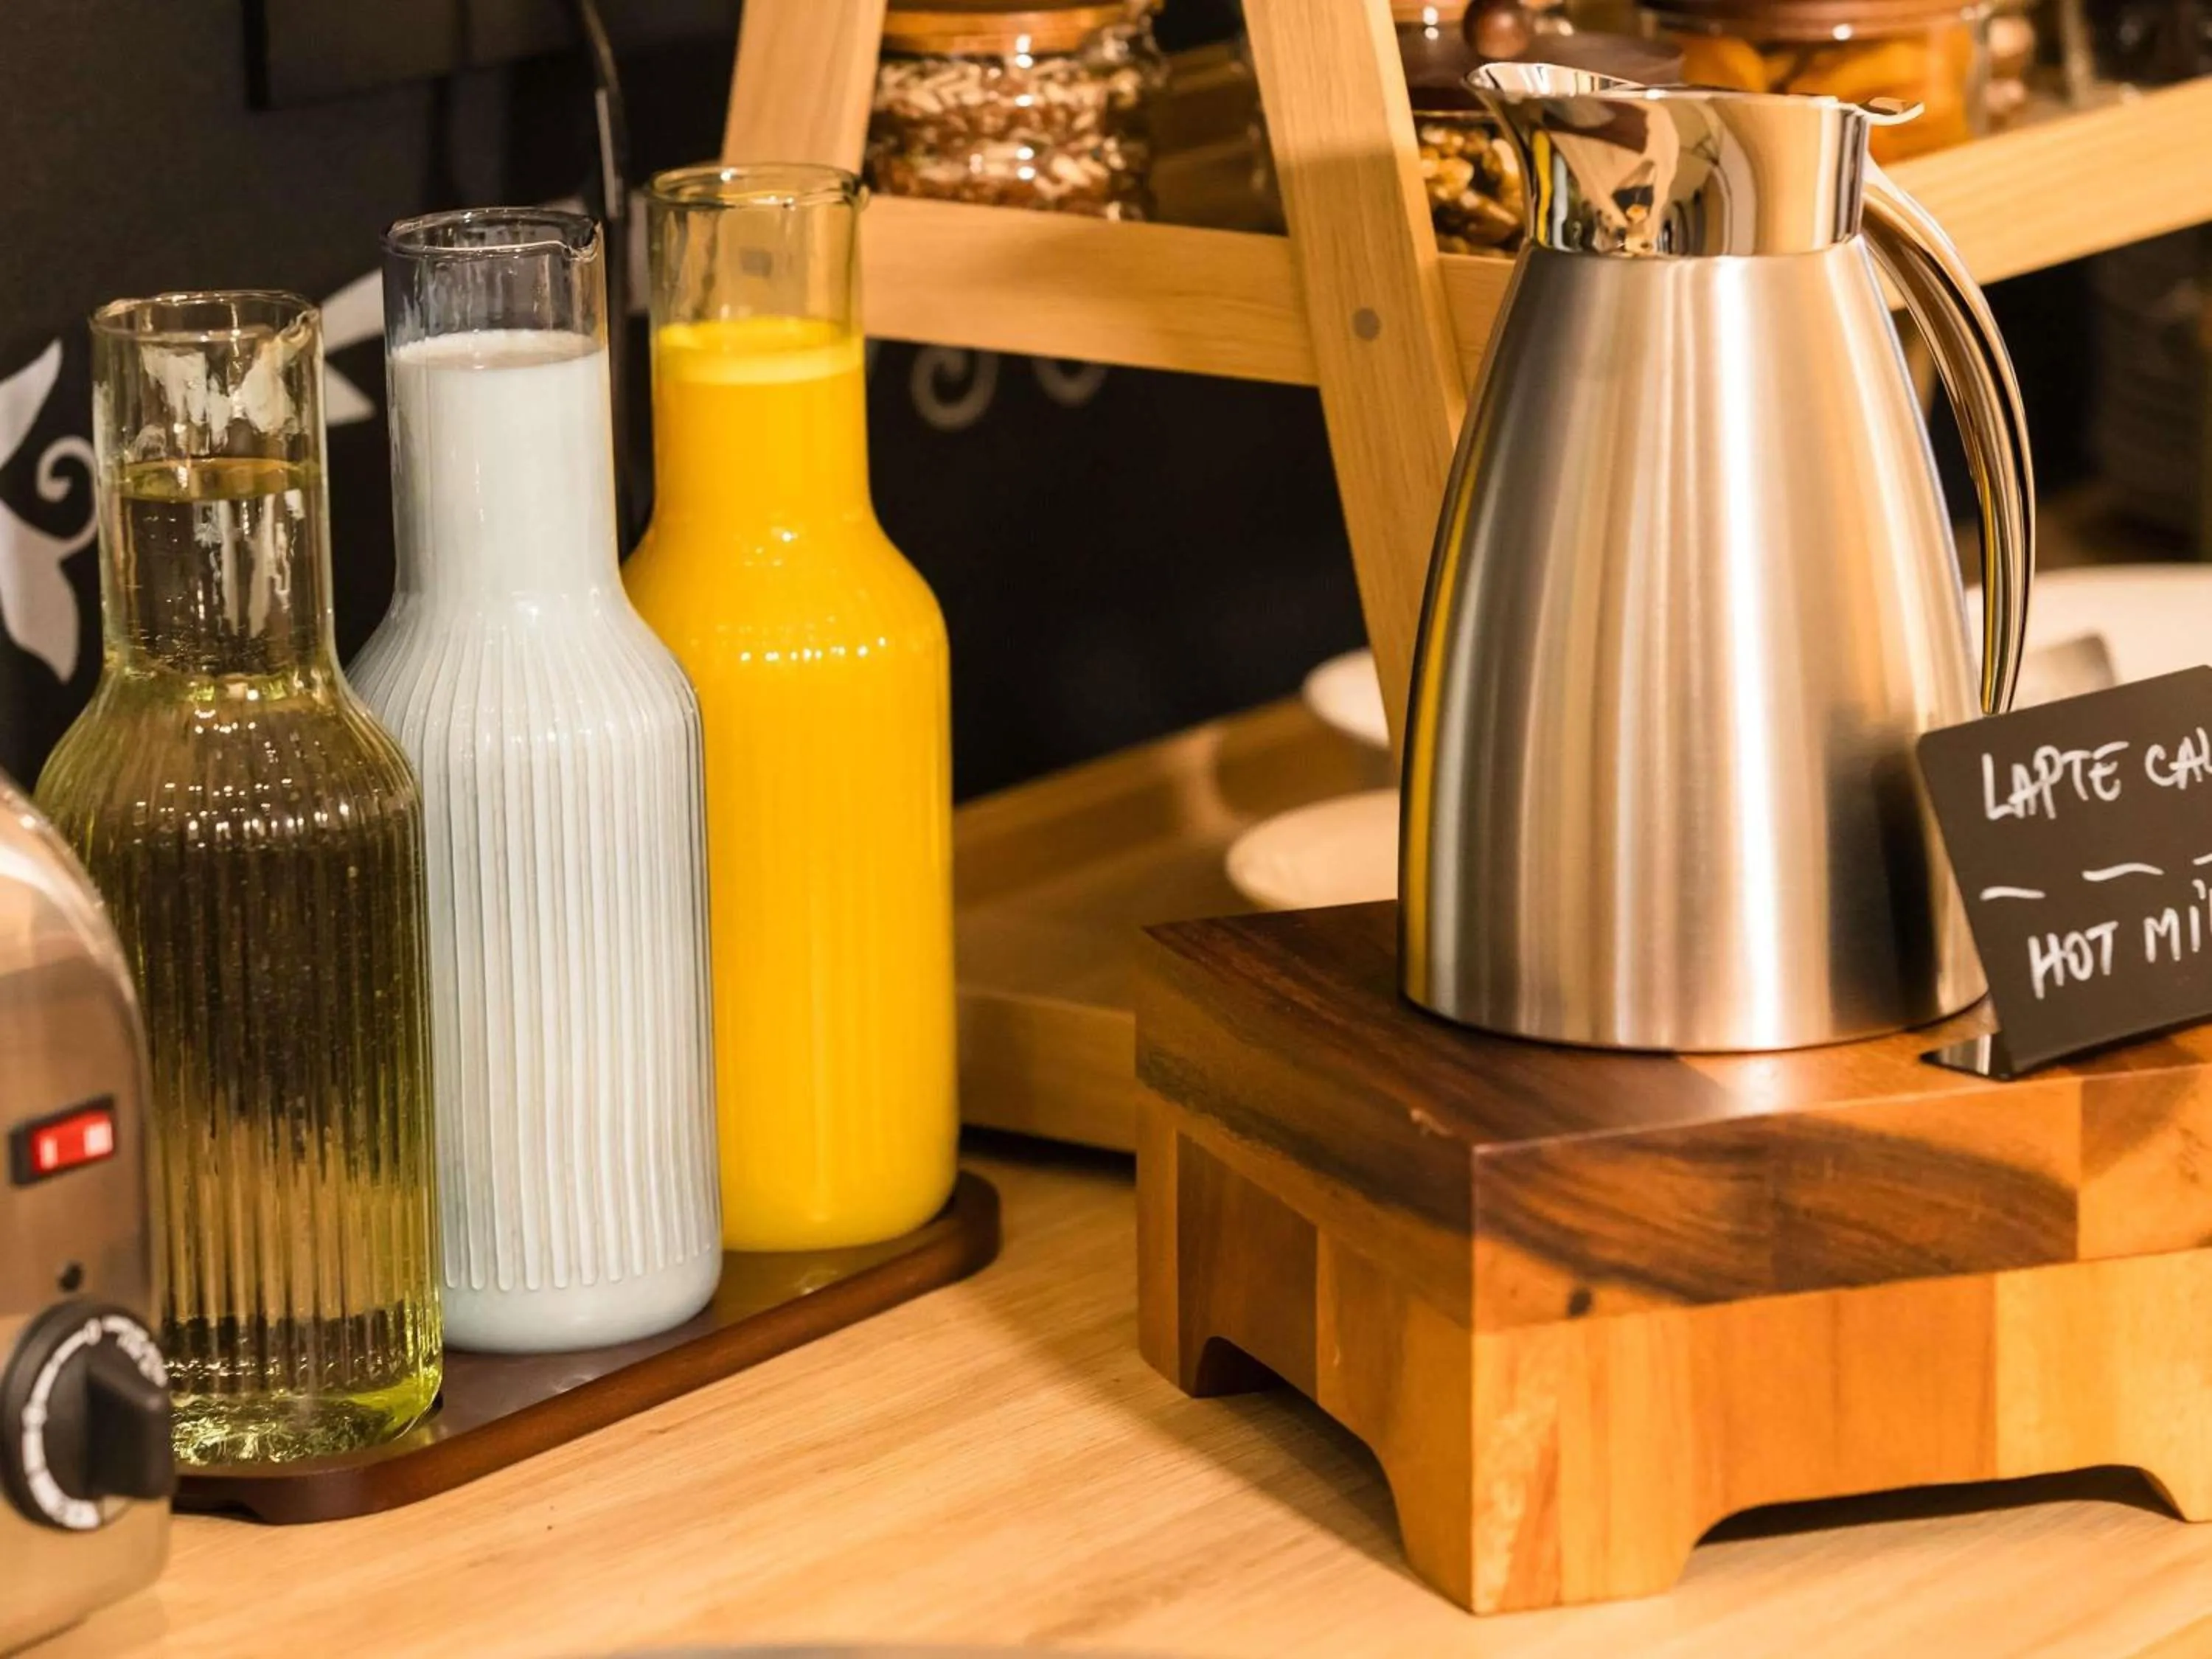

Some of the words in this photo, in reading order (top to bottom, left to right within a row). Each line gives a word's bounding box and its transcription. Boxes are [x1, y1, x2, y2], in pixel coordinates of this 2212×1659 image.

[1981, 741, 2129, 820] LAPTE
[2028, 920, 2119, 999] HOT
[2143, 879, 2212, 963] MI
